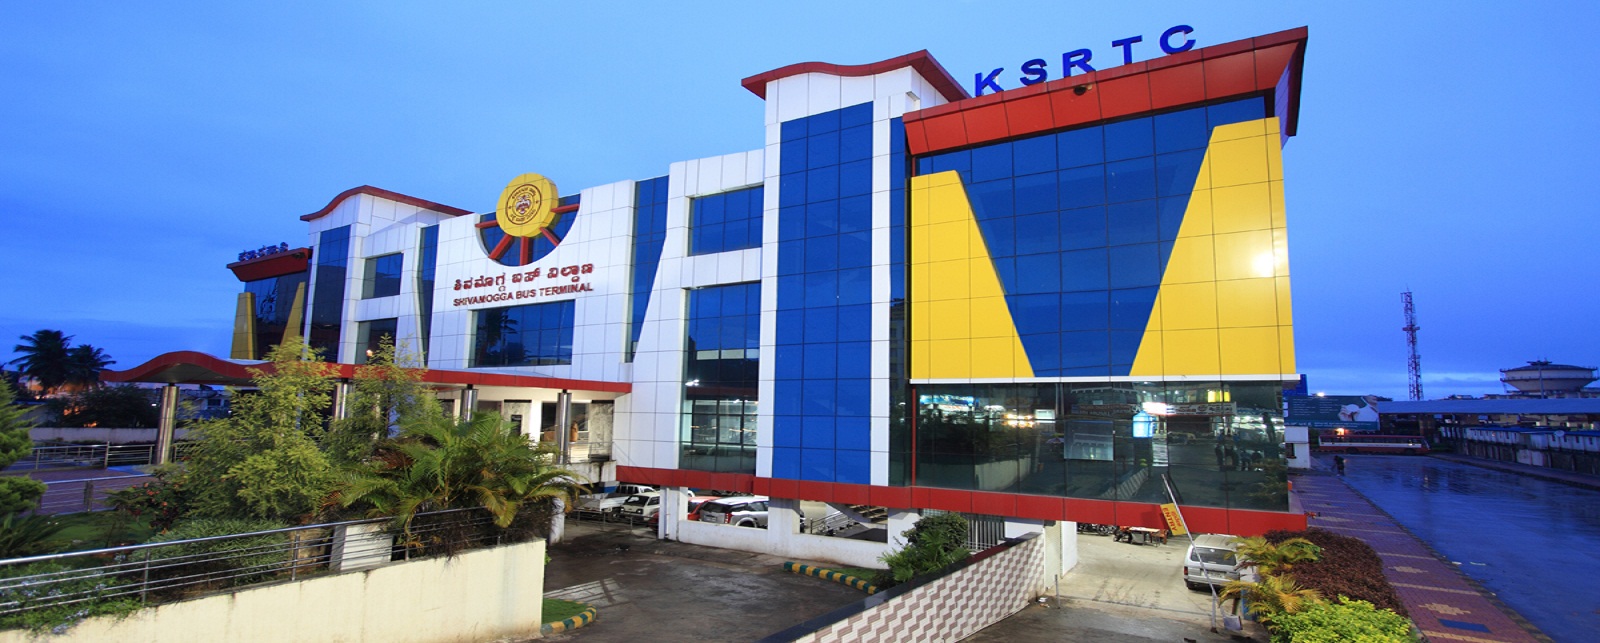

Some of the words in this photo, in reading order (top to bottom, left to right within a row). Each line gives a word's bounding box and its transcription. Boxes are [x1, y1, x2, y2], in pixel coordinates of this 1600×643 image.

[975, 24, 1196, 97] KSRTC
[453, 272, 506, 292] ಶಿವಮೊಗ್ಗ
[512, 267, 540, 284] ಬಸ್
[453, 292, 514, 307] SHIVAMOGGA
[516, 288, 537, 300] BUS
[539, 282, 594, 297] TERMINAL
[1162, 507, 1178, 532] ENTRY
